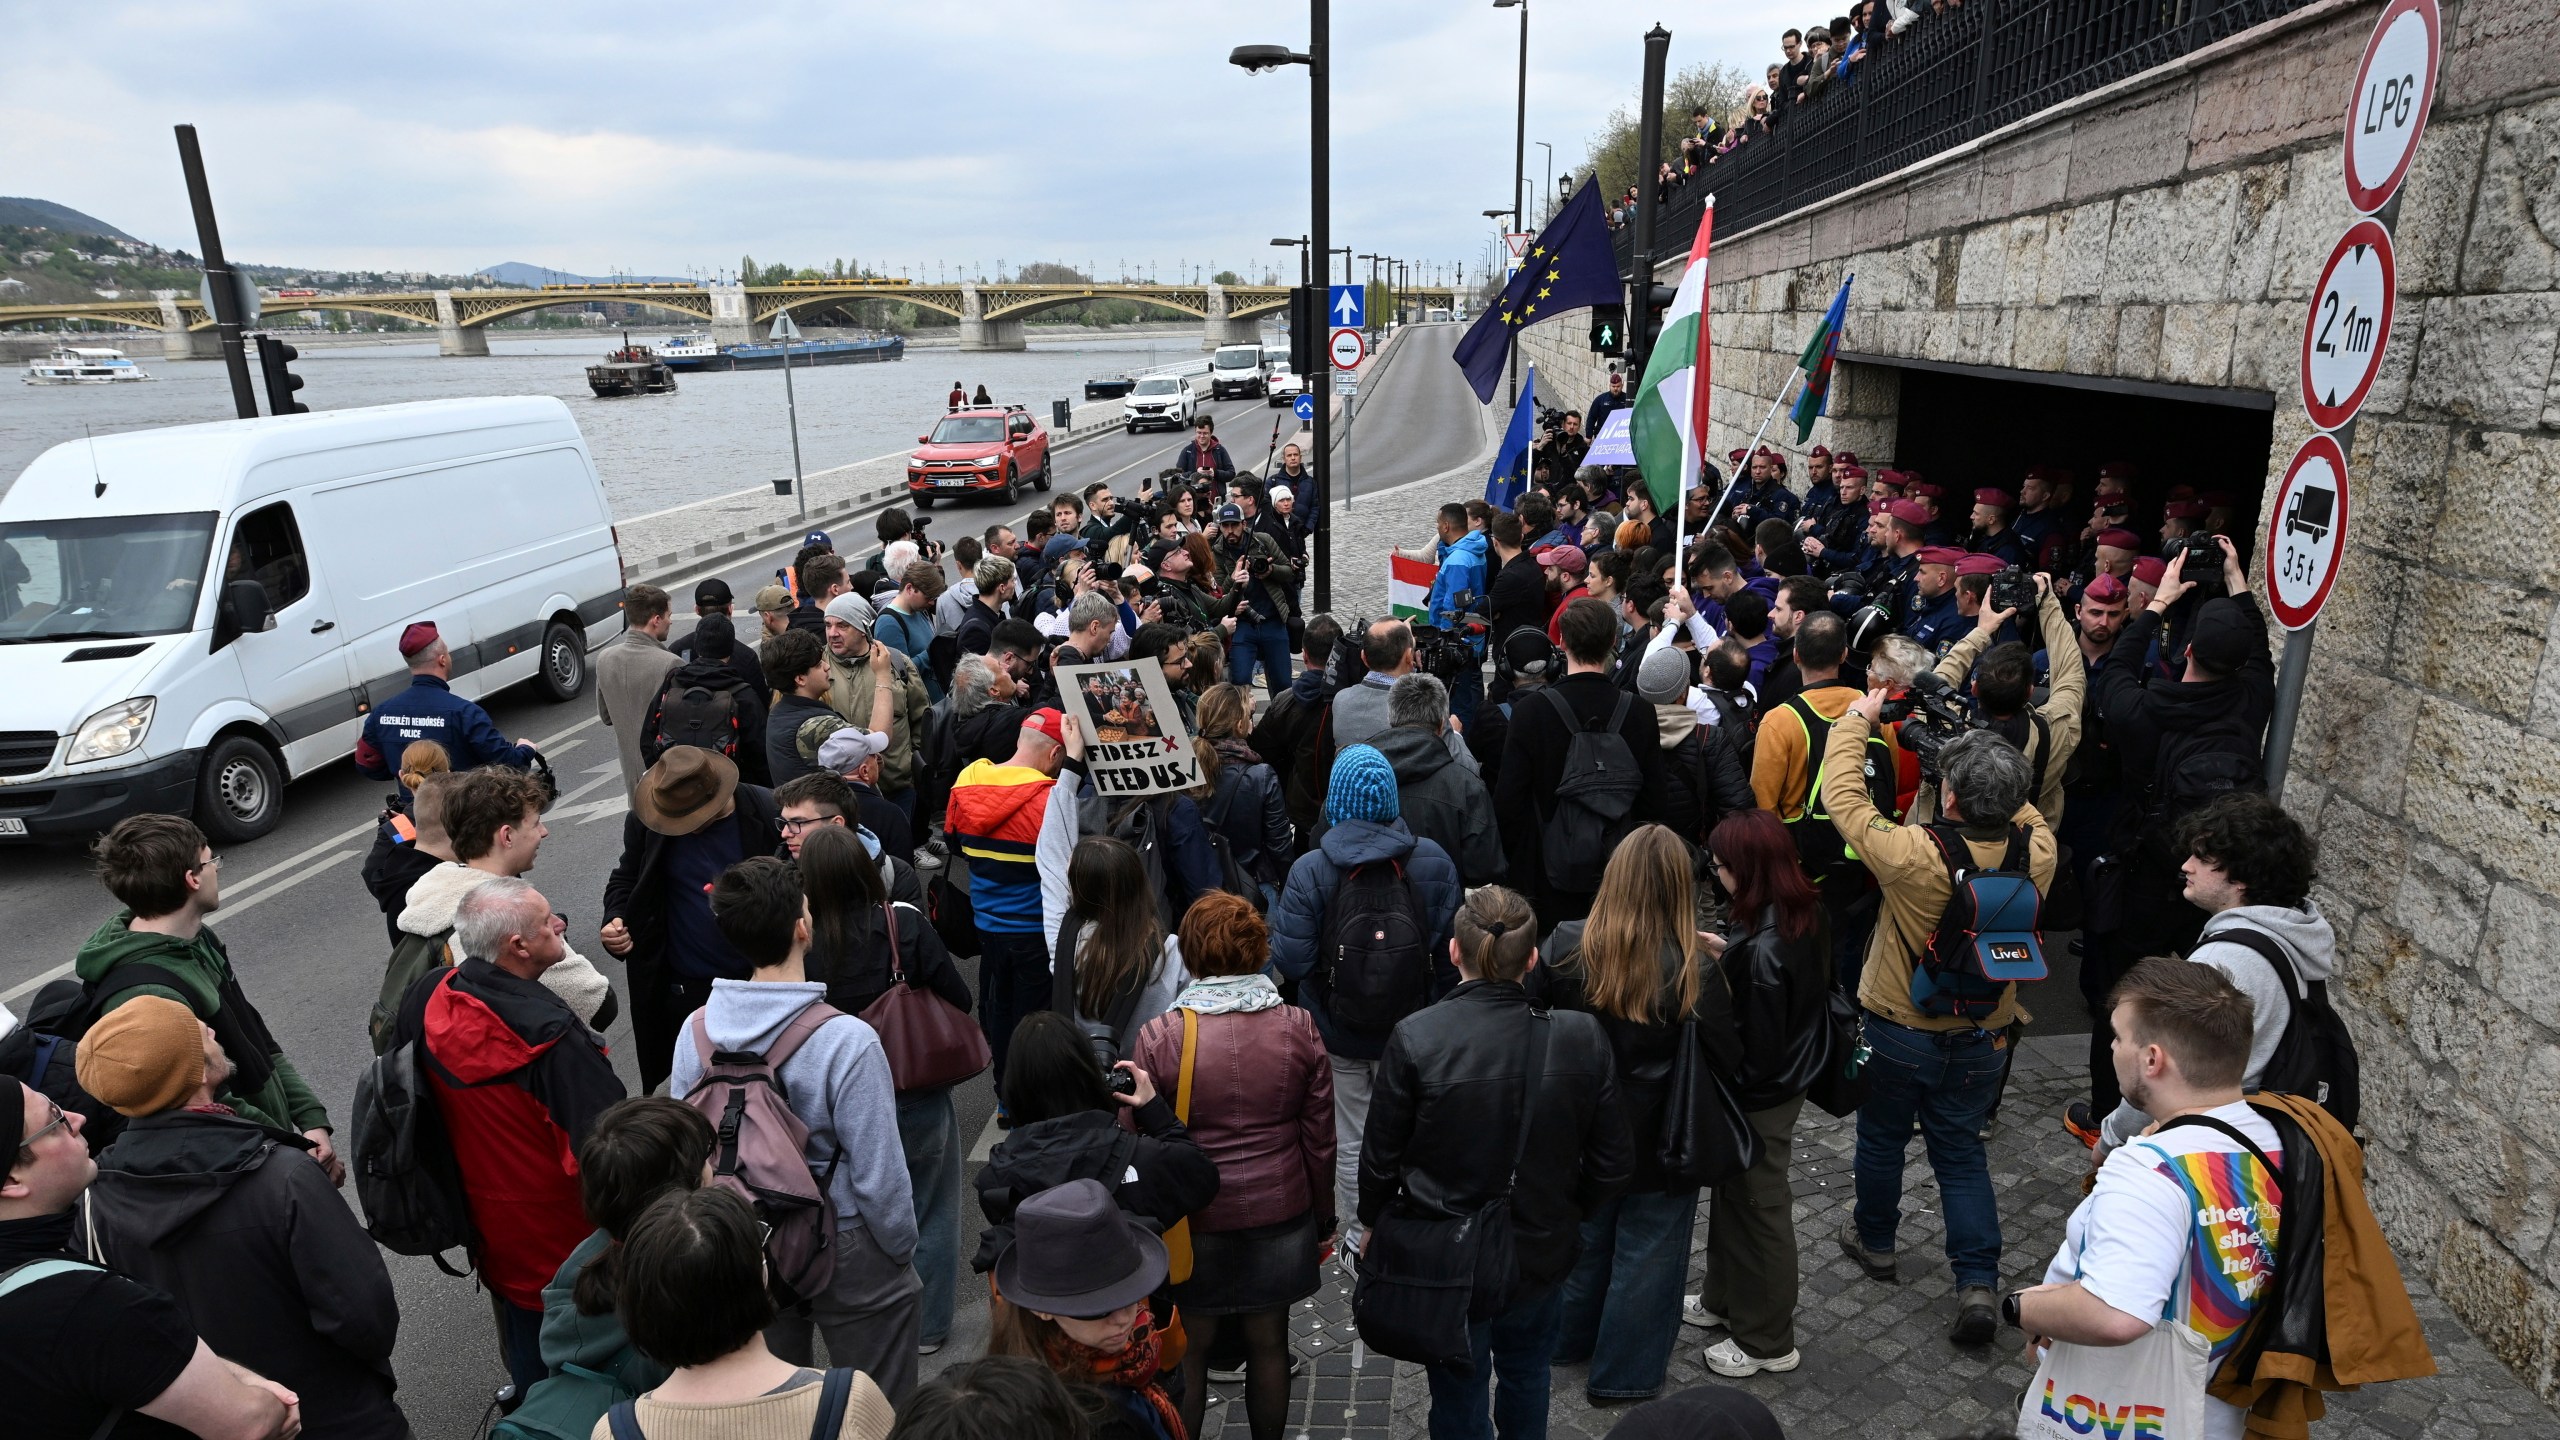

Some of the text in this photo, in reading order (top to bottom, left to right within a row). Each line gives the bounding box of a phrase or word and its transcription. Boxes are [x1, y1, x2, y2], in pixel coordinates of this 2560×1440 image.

[2364, 74, 2413, 134] LPG
[2284, 545, 2314, 587] 3,5 t
[380, 714, 410, 726] KÉSZENLÉTI
[400, 728, 422, 739] POLICE
[1085, 741, 1160, 762] FIDESZ
[1093, 761, 1187, 792] FEED US
[2041, 1377, 2165, 1440] LOVE
